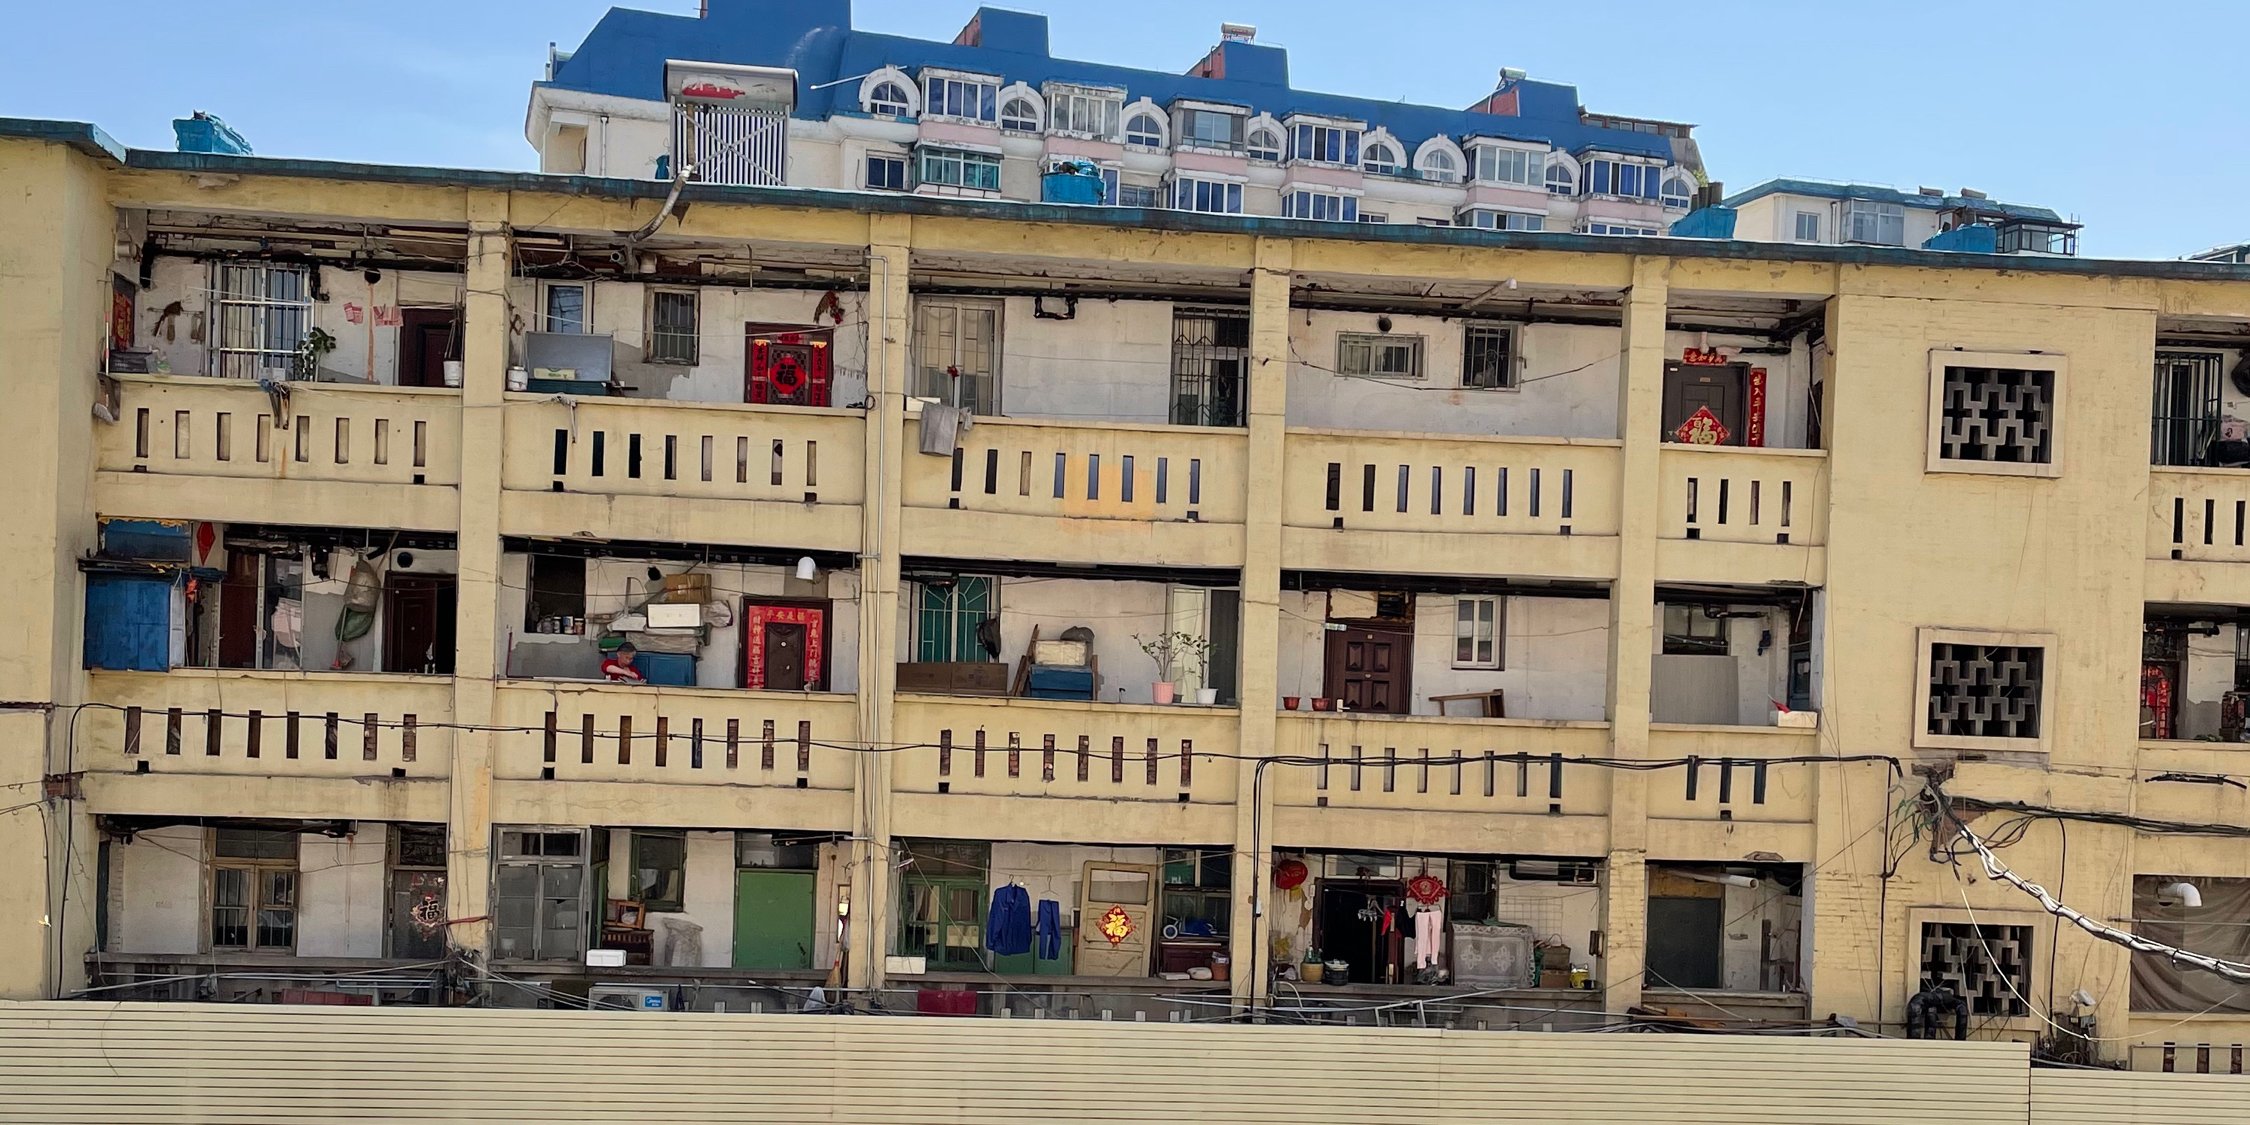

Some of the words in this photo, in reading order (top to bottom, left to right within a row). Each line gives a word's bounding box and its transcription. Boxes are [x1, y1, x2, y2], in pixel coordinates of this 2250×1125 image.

[776, 363, 798, 386] 福
[766, 609, 805, 621] 平安是福
[420, 900, 440, 920] 福
[1105, 913, 1128, 938] 福
